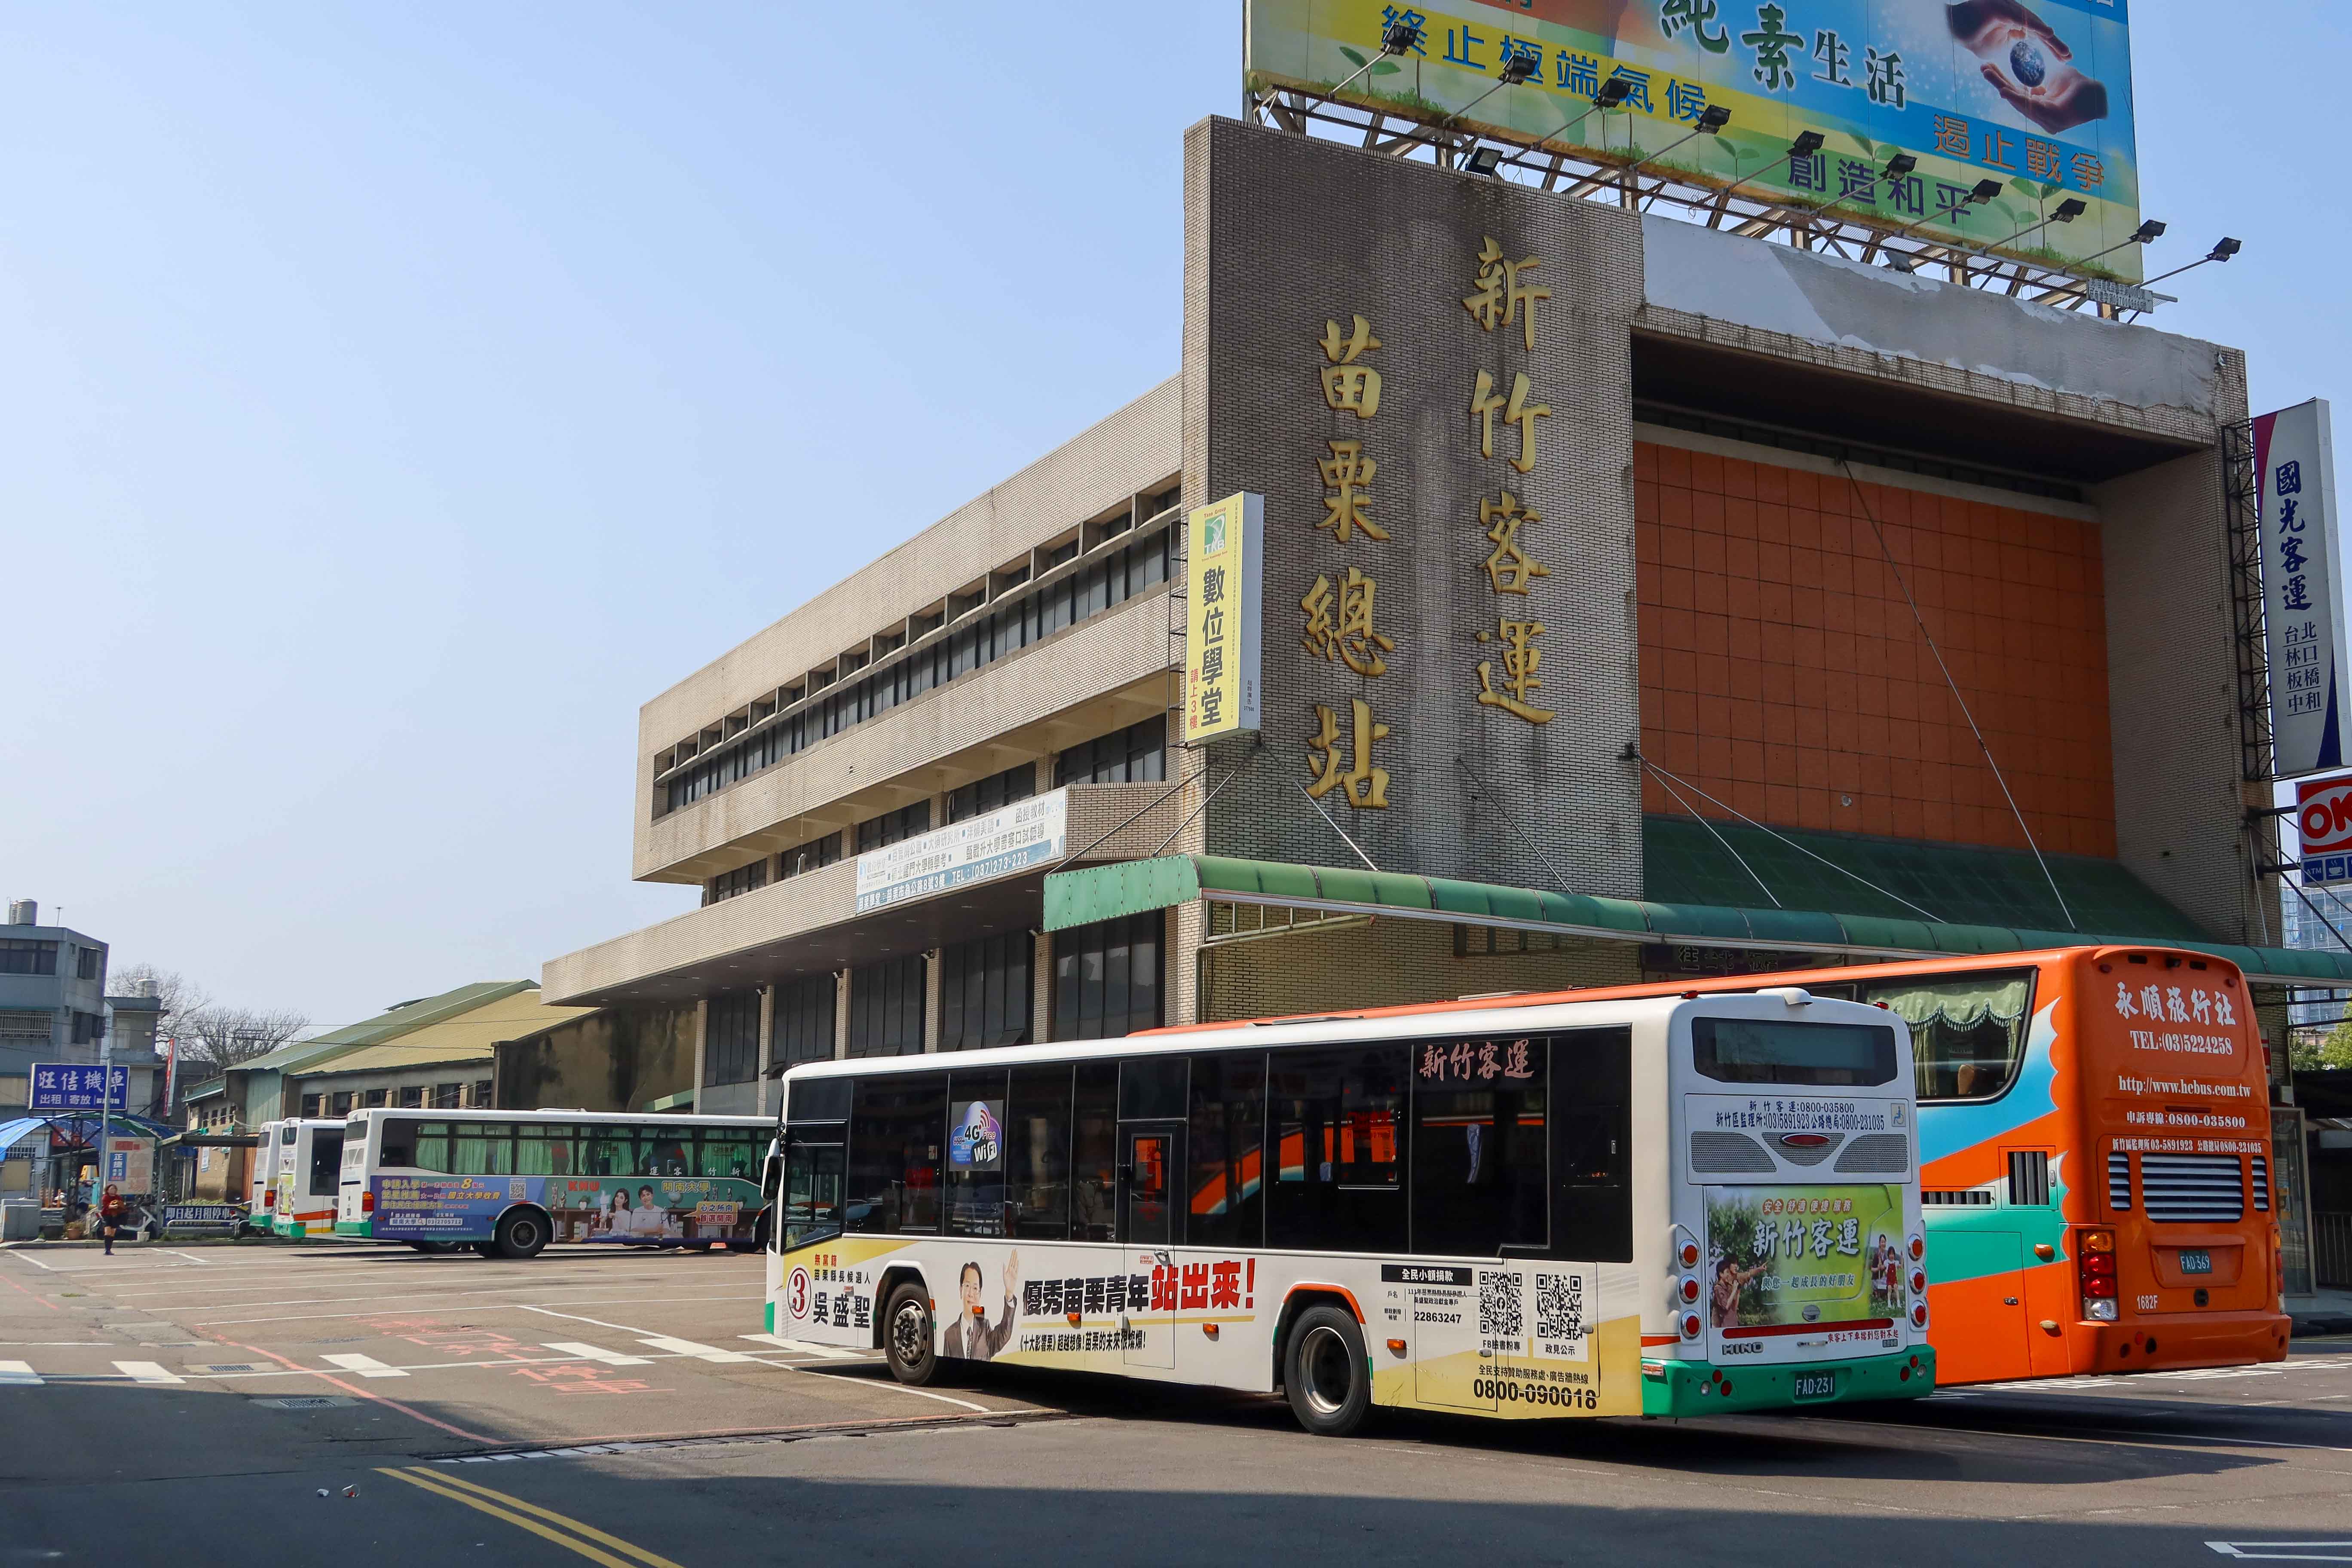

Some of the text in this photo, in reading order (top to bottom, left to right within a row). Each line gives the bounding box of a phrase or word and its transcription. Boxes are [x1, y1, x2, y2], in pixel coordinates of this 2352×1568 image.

[1934, 113, 2104, 190] 遏止戰爭
[1788, 155, 1972, 225] 創造和平
[1462, 235, 1555, 725] 新竹客運
[2275, 460, 2312, 611] 國光客運
[1204, 539, 1225, 555] TKB
[1301, 315, 1395, 809] 苗栗總站
[2284, 622, 2317, 643] 台北
[1200, 564, 1225, 727] 數位學堂
[2285, 645, 2318, 667] 林口
[2287, 669, 2320, 690] 板橋
[1189, 668, 1199, 730] 請上3樓
[2288, 692, 2321, 713] 中和
[2115, 981, 2236, 1026] 永順旅行社
[2130, 1030, 2233, 1055] TEL:(03)5224258
[1420, 1039, 1534, 1081] 新竹客運
[2118, 1075, 2251, 1097] http://www.hcbus.com.tw
[40, 1094, 61, 1104] 出租
[69, 1094, 91, 1105] 寄放
[2127, 1111, 2245, 1128] 申訴專線:0800-035800
[965, 1124, 996, 1141] 4G Free
[662, 1182, 710, 1193] 開南大學
[1764, 1200, 1852, 1213] 安全 舒適 便捷 服務
[700, 1215, 732, 1223] 首選開南
[1753, 1217, 1860, 1258] 新竹客運
[815, 1254, 837, 1267] 無黨籍
[2180, 1255, 2210, 1270] FAD-369
[814, 1269, 870, 1284] 苗栗縣長候選人
[1402, 1268, 1453, 1282] 全民小額捐款
[1761, 1274, 1855, 1290] 與您一起成長的好朋友
[793, 1273, 805, 1313] 3
[1387, 1290, 1398, 1298] 戶名
[2137, 1295, 2158, 1310] 1682F
[813, 1292, 870, 1328] 吳盛聖
[1414, 1311, 1462, 1323] 22863247
[1545, 1344, 1576, 1356] 政見公示
[1722, 1341, 1764, 1355] HINO
[1473, 1378, 1597, 1410] 0800-090018
[1796, 1377, 1833, 1396] FAD-231
